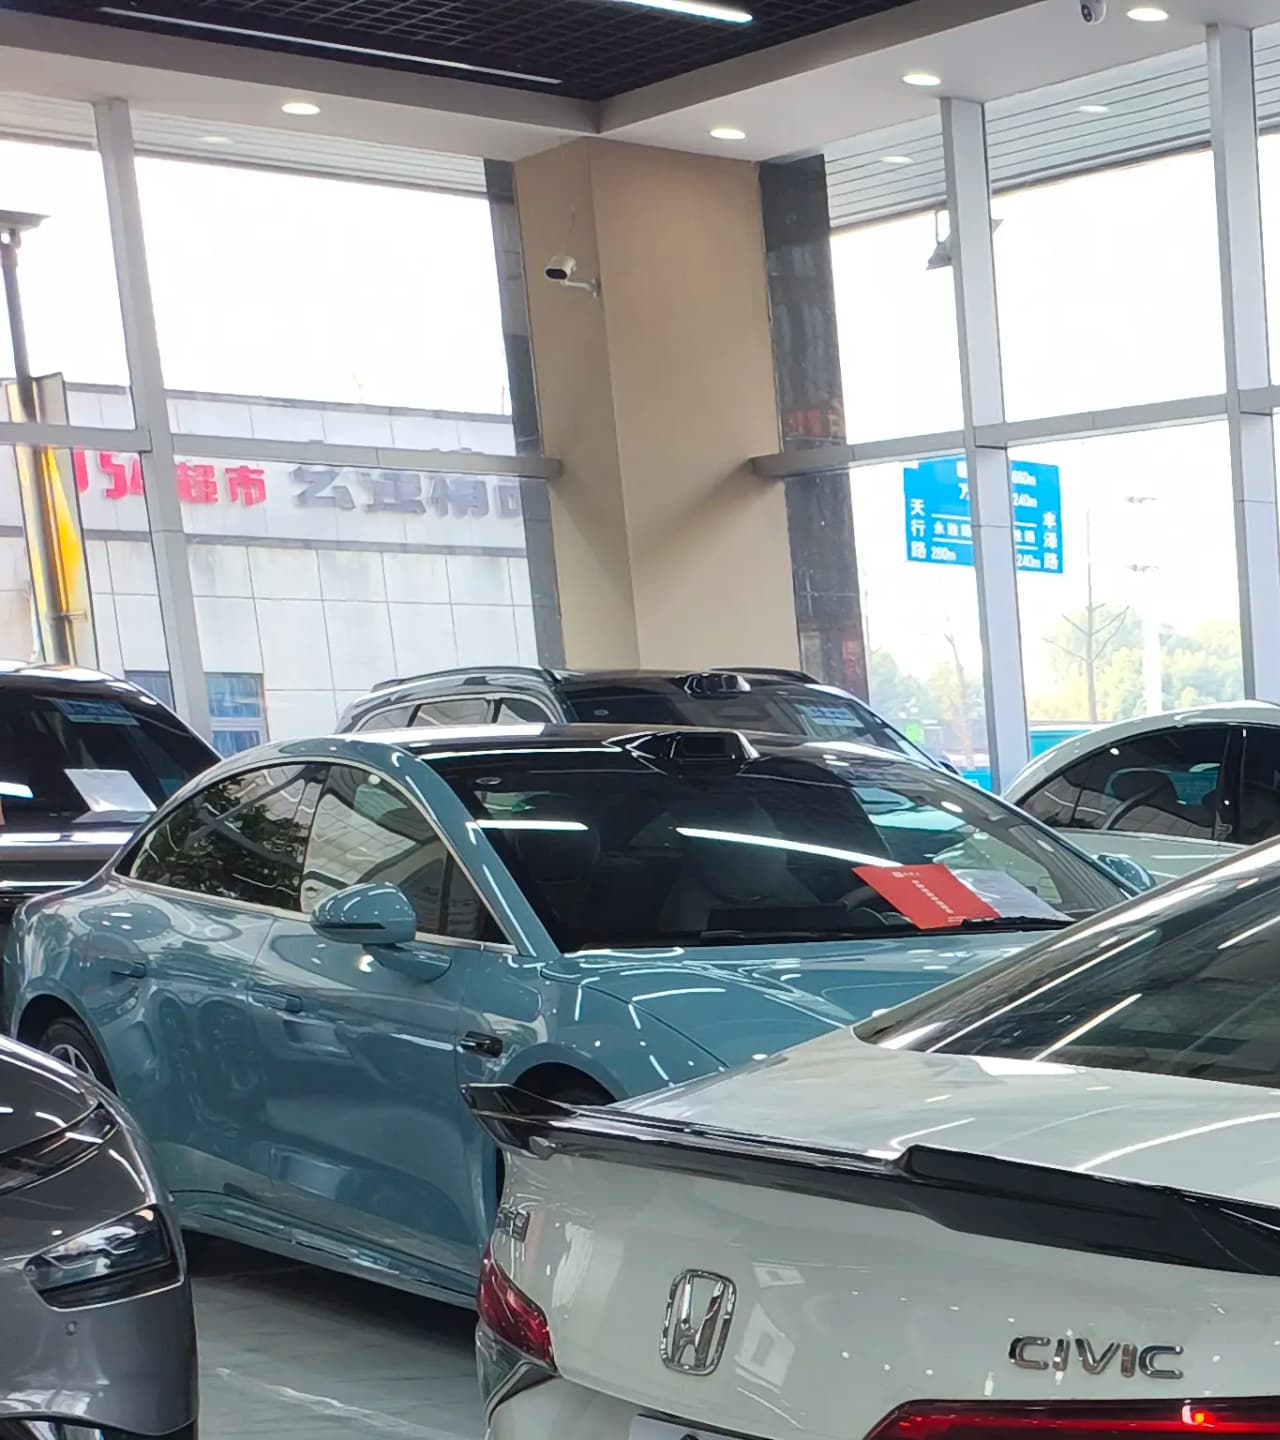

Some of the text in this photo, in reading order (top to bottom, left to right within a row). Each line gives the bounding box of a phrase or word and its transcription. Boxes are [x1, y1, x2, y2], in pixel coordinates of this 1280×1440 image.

[910, 498, 927, 560] 天行路
[1008, 1336, 1185, 1380] CIVIC
